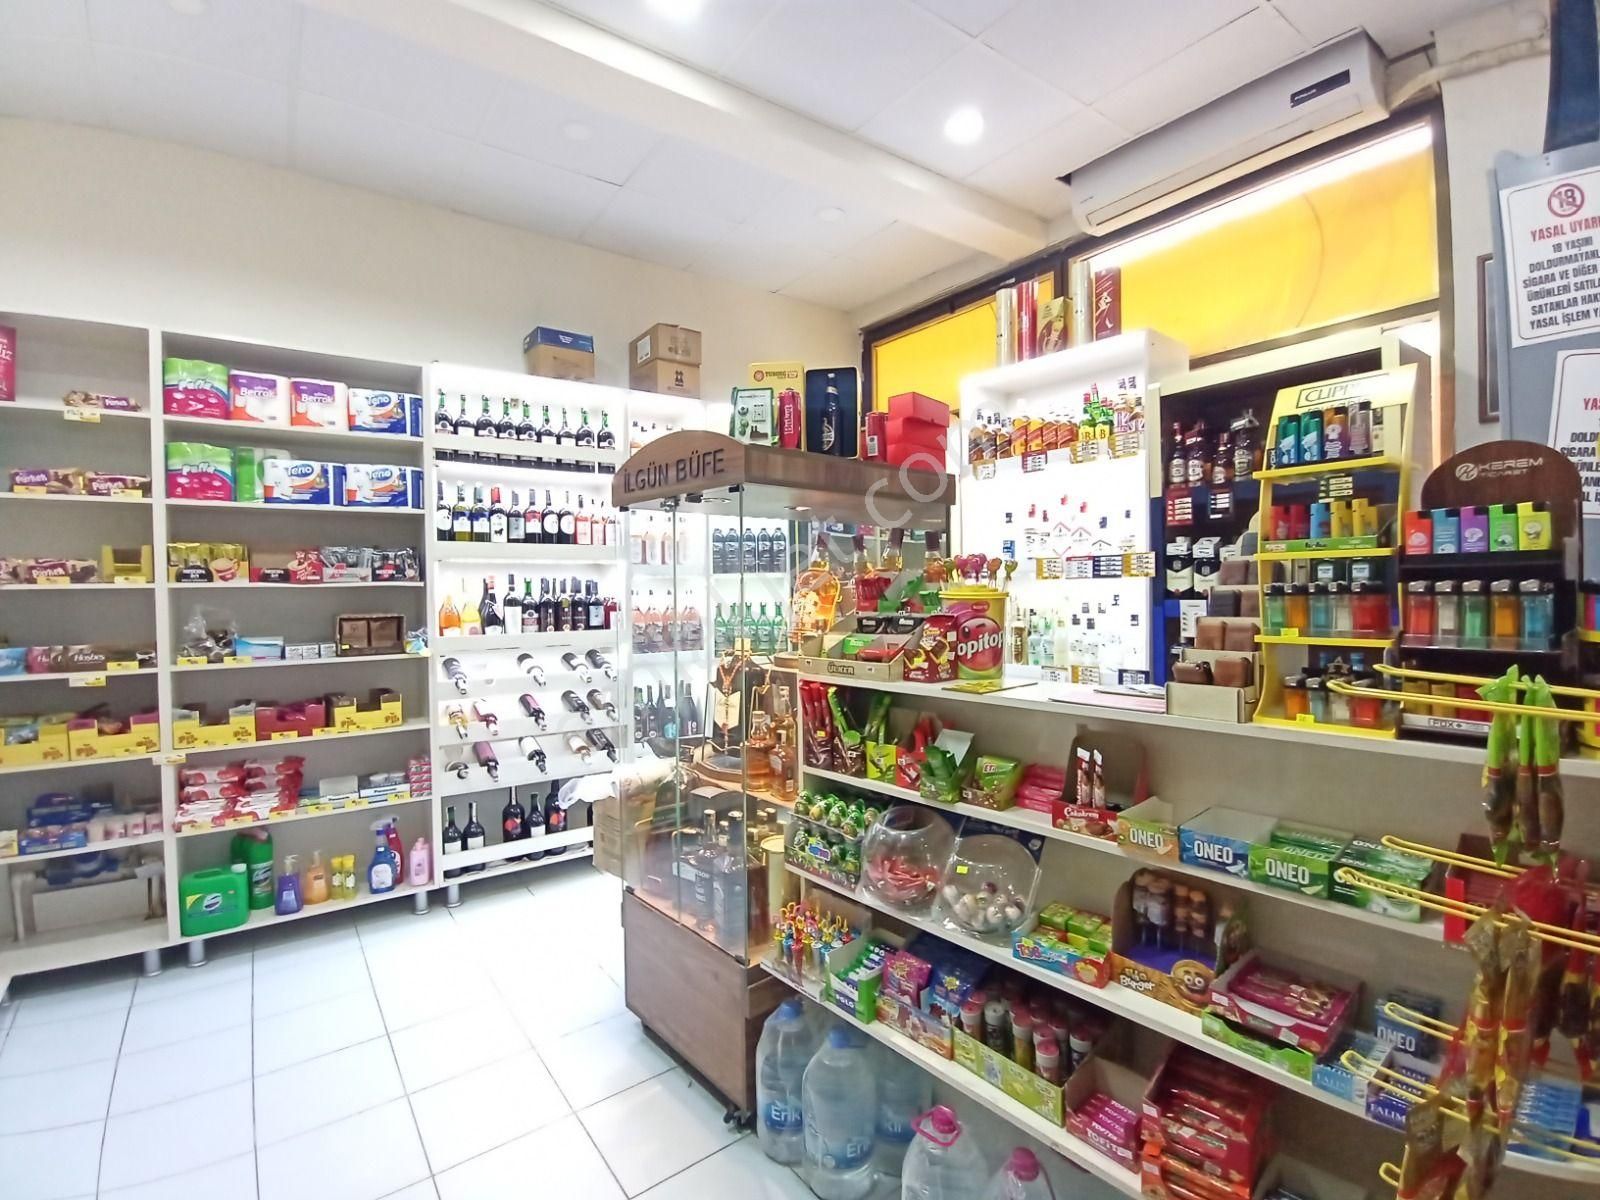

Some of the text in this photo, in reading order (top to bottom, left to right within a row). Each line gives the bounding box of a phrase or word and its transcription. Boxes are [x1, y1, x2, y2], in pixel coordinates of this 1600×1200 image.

[1530, 223, 1566, 242] YASAL
[1565, 236, 1593, 251] YAŞINI
[1523, 263, 1598, 289] SİGARA VE DİĞER
[1527, 284, 1571, 302] ÜRÜNLERİ
[1531, 297, 1579, 316] SATANLAR
[1530, 315, 1560, 330] YASAL
[1562, 309, 1591, 326] İŞLEM
[287, 464, 312, 477] Teno
[624, 448, 726, 494] İLGÜN BÜFE
[1478, 457, 1543, 471] KEREM
[1129, 827, 1164, 849] ONEO
[1193, 840, 1233, 864] ONEO
[1265, 857, 1310, 885] ONEO
[1376, 1026, 1416, 1052] ONEO
[1369, 1103, 1407, 1124] FALIM
